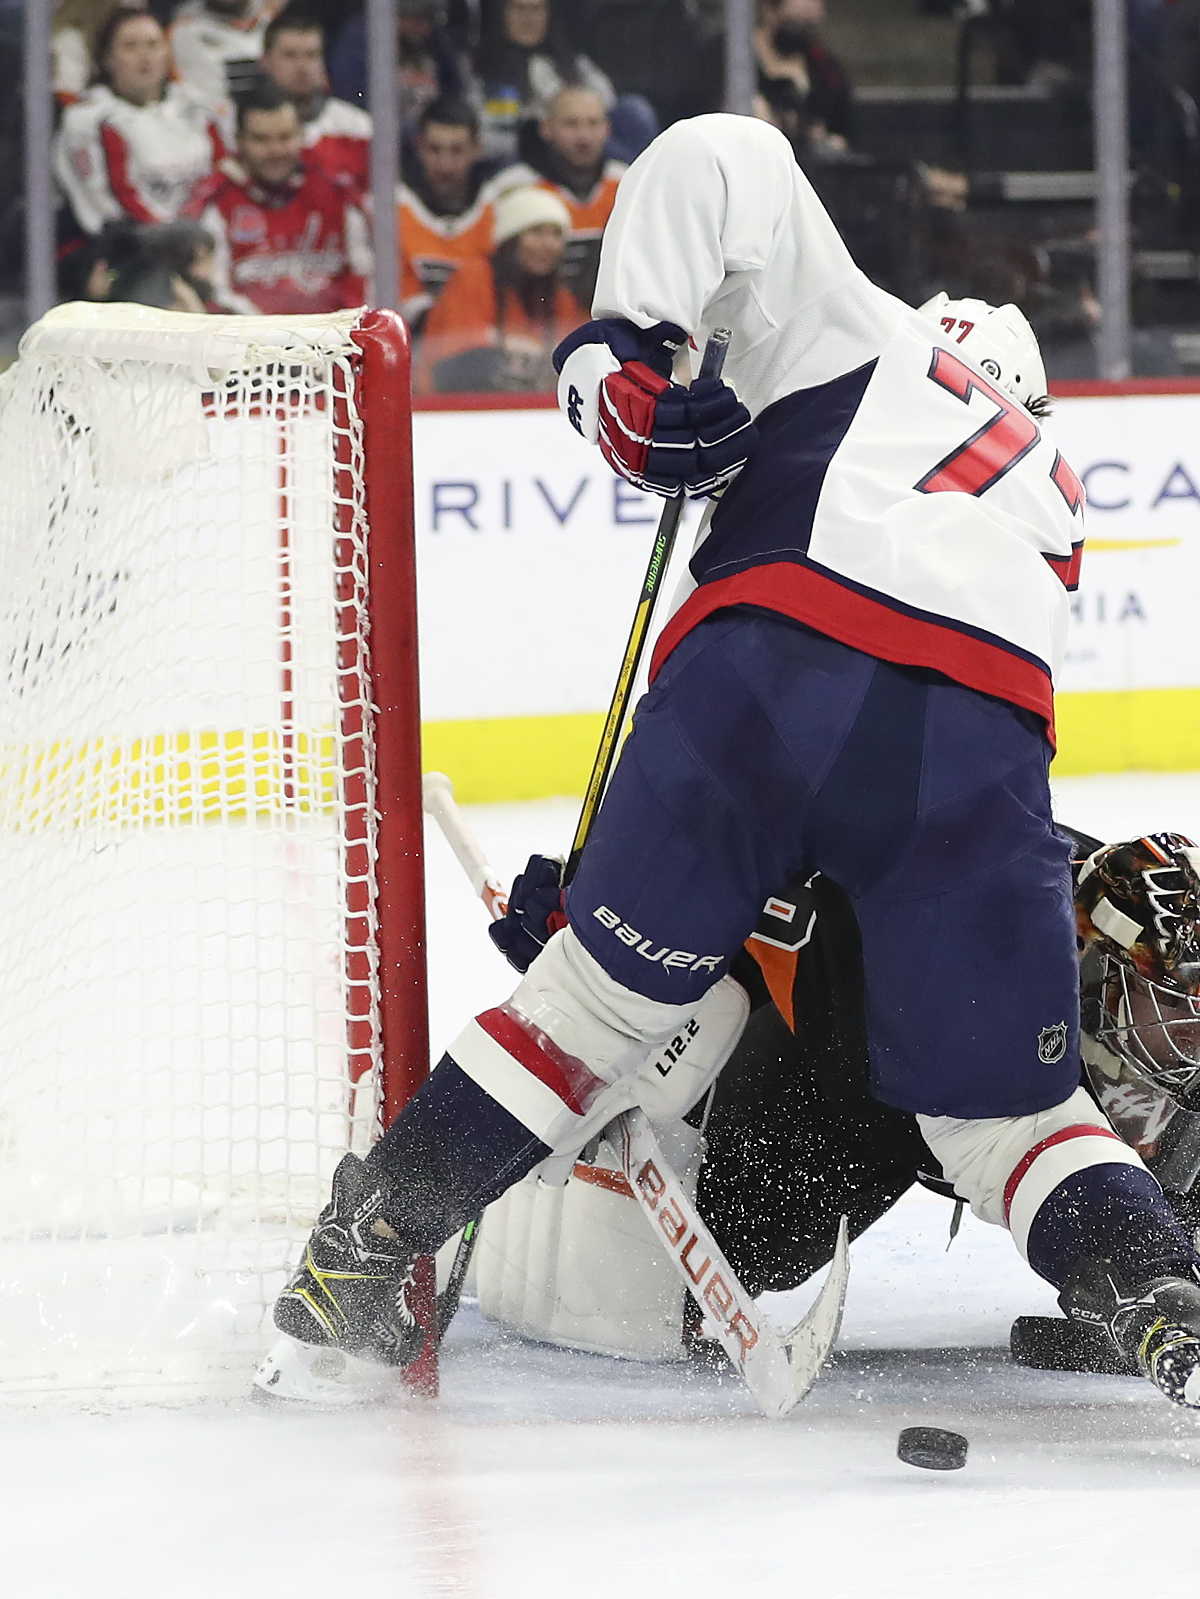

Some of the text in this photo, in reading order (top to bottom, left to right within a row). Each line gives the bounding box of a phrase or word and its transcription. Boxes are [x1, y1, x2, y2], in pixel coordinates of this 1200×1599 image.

[940, 317, 975, 345] 77
[430, 474, 700, 532] RIVE
[645, 532, 667, 594] SUPREME
[592, 905, 725, 973] BAUER
[655, 1018, 700, 1078] L12.2
[353, 1188, 383, 1220] CCM
[635, 1158, 759, 1364] BAUER
[1070, 1306, 1103, 1321] CCM
